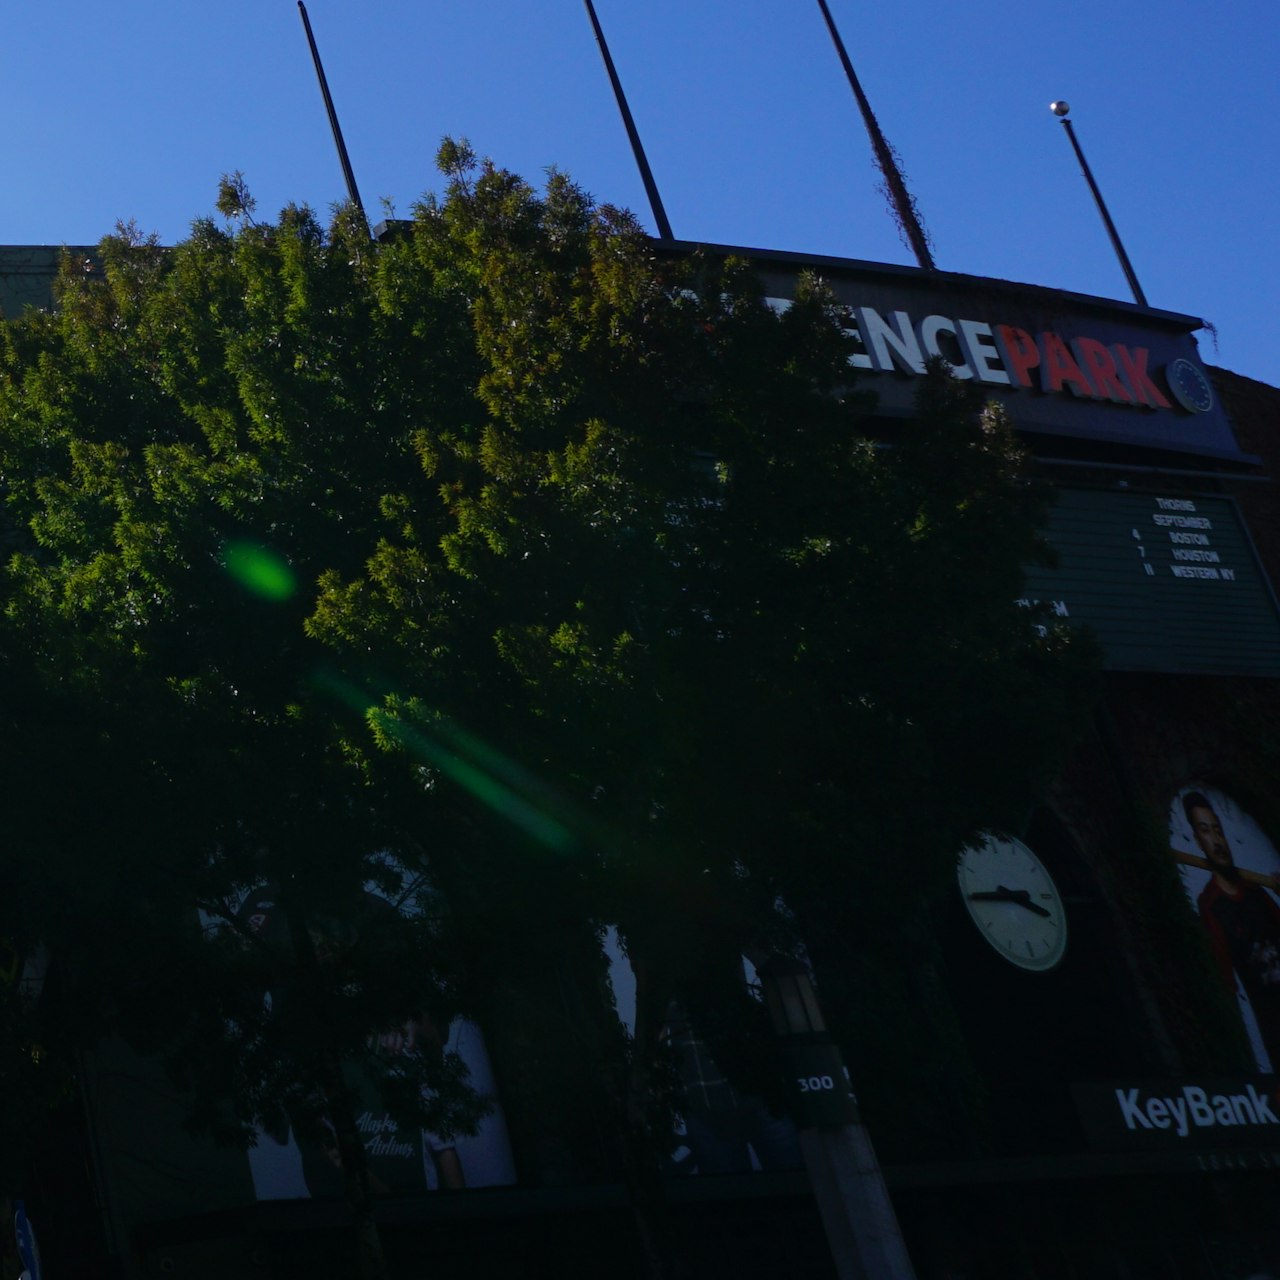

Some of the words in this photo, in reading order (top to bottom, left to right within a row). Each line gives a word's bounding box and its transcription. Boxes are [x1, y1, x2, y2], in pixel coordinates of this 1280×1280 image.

[1154, 497, 1197, 512] THORNS
[1152, 513, 1213, 530] SEPTEMBER
[1169, 531, 1211, 546] BOSTON
[1171, 548, 1220, 563] HOUSTON
[1170, 564, 1220, 580] WESTERN
[1219, 568, 1236, 581] NY
[796, 1075, 834, 1092] 300
[1114, 1083, 1280, 1138] KeyBank
[355, 1111, 399, 1135] Alaska
[363, 1134, 417, 1159] Airlines
